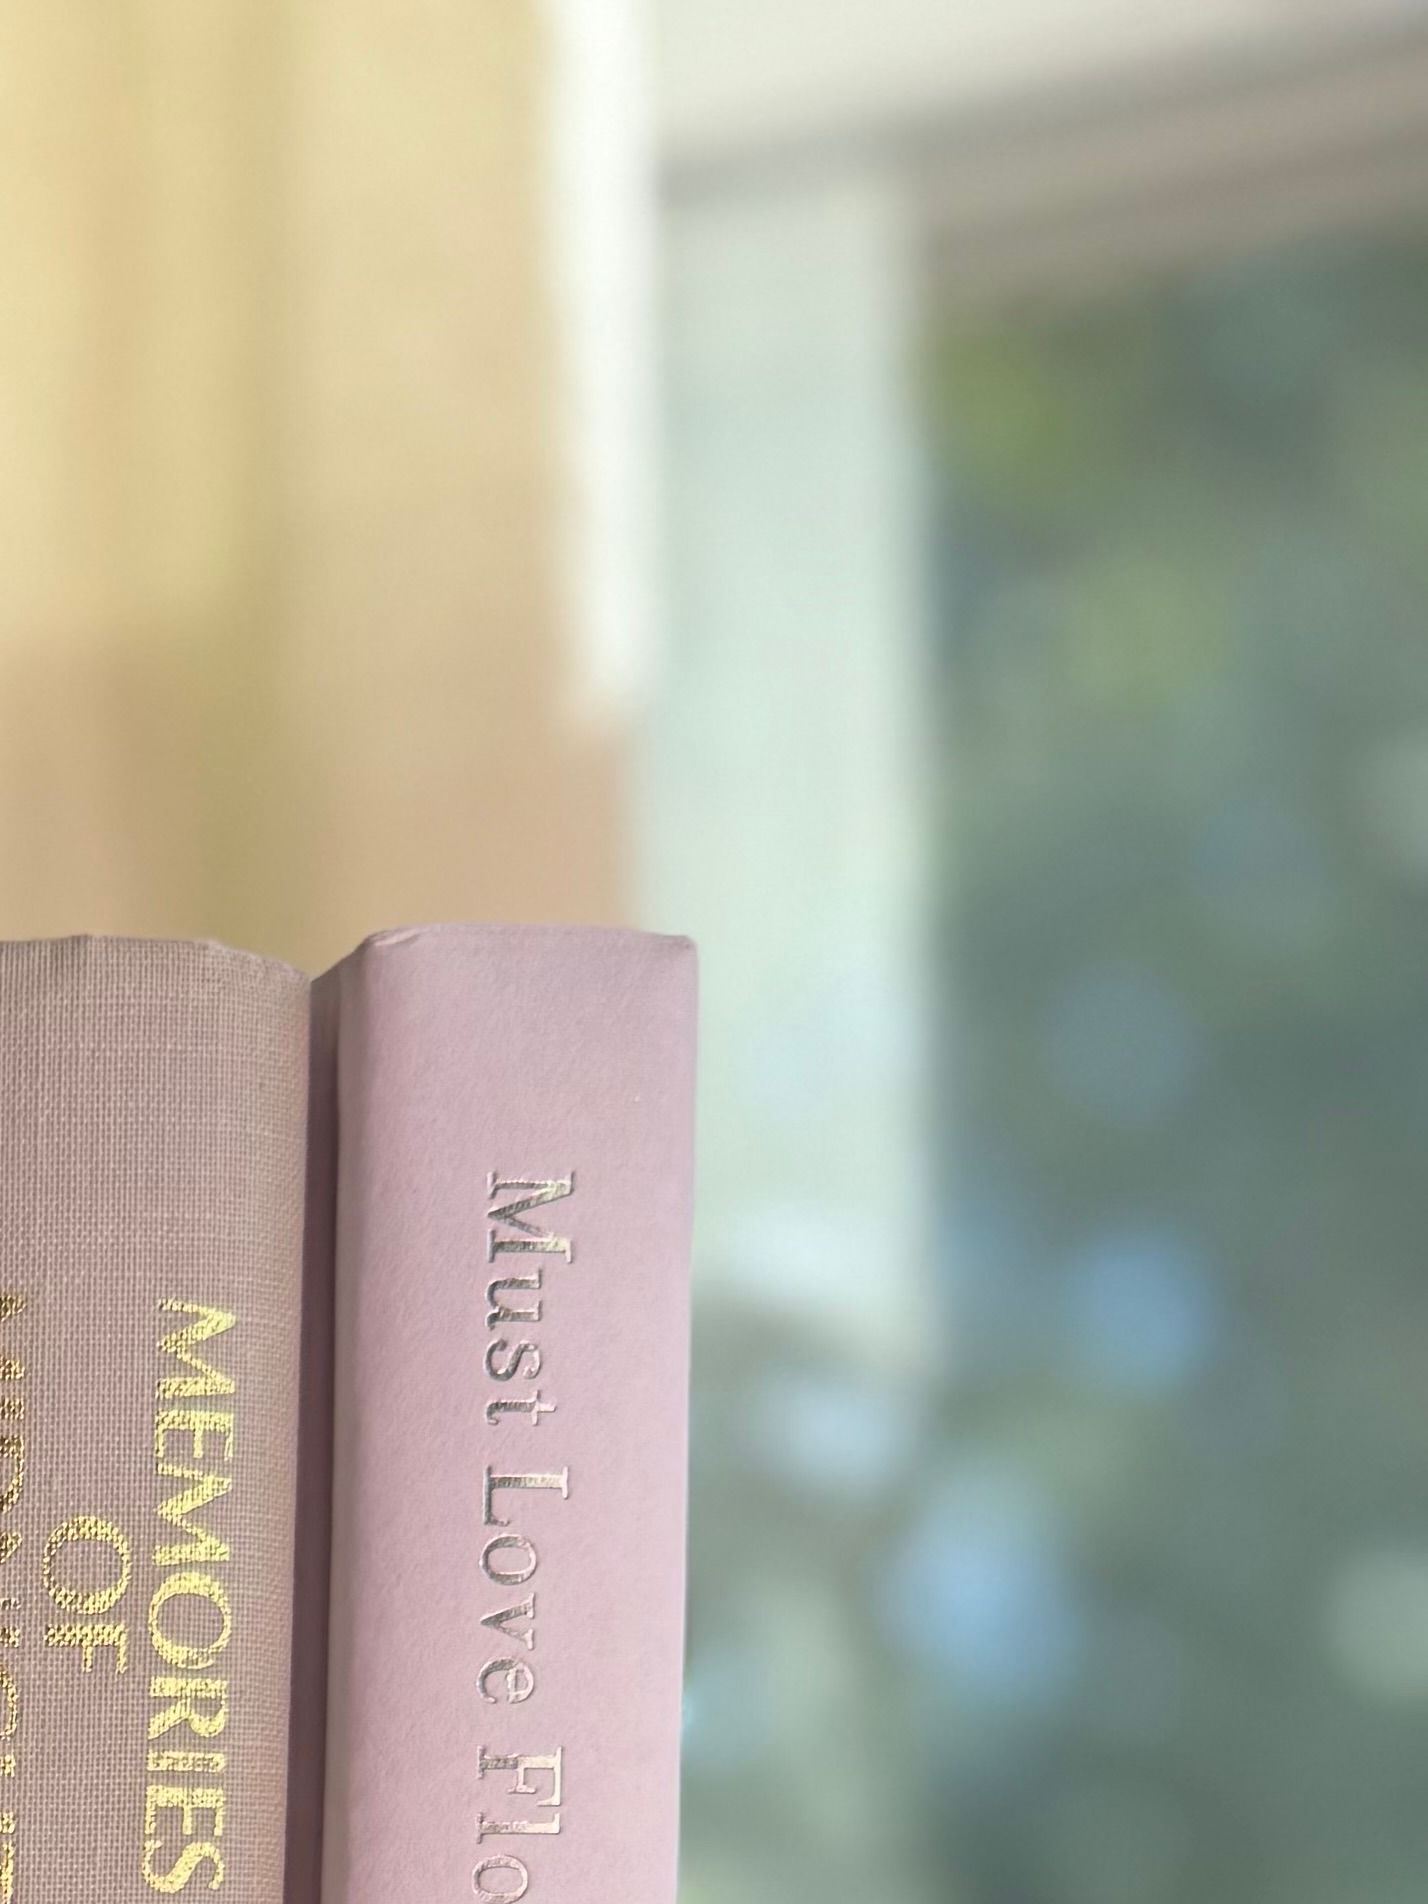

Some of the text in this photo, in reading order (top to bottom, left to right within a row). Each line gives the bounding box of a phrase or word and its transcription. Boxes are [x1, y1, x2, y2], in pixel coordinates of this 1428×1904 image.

[483, 1171, 575, 1427] Must
[43, 1514, 133, 1674] OF
[141, 1298, 238, 1894] MEMORIES
[475, 1466, 570, 1707] Love
